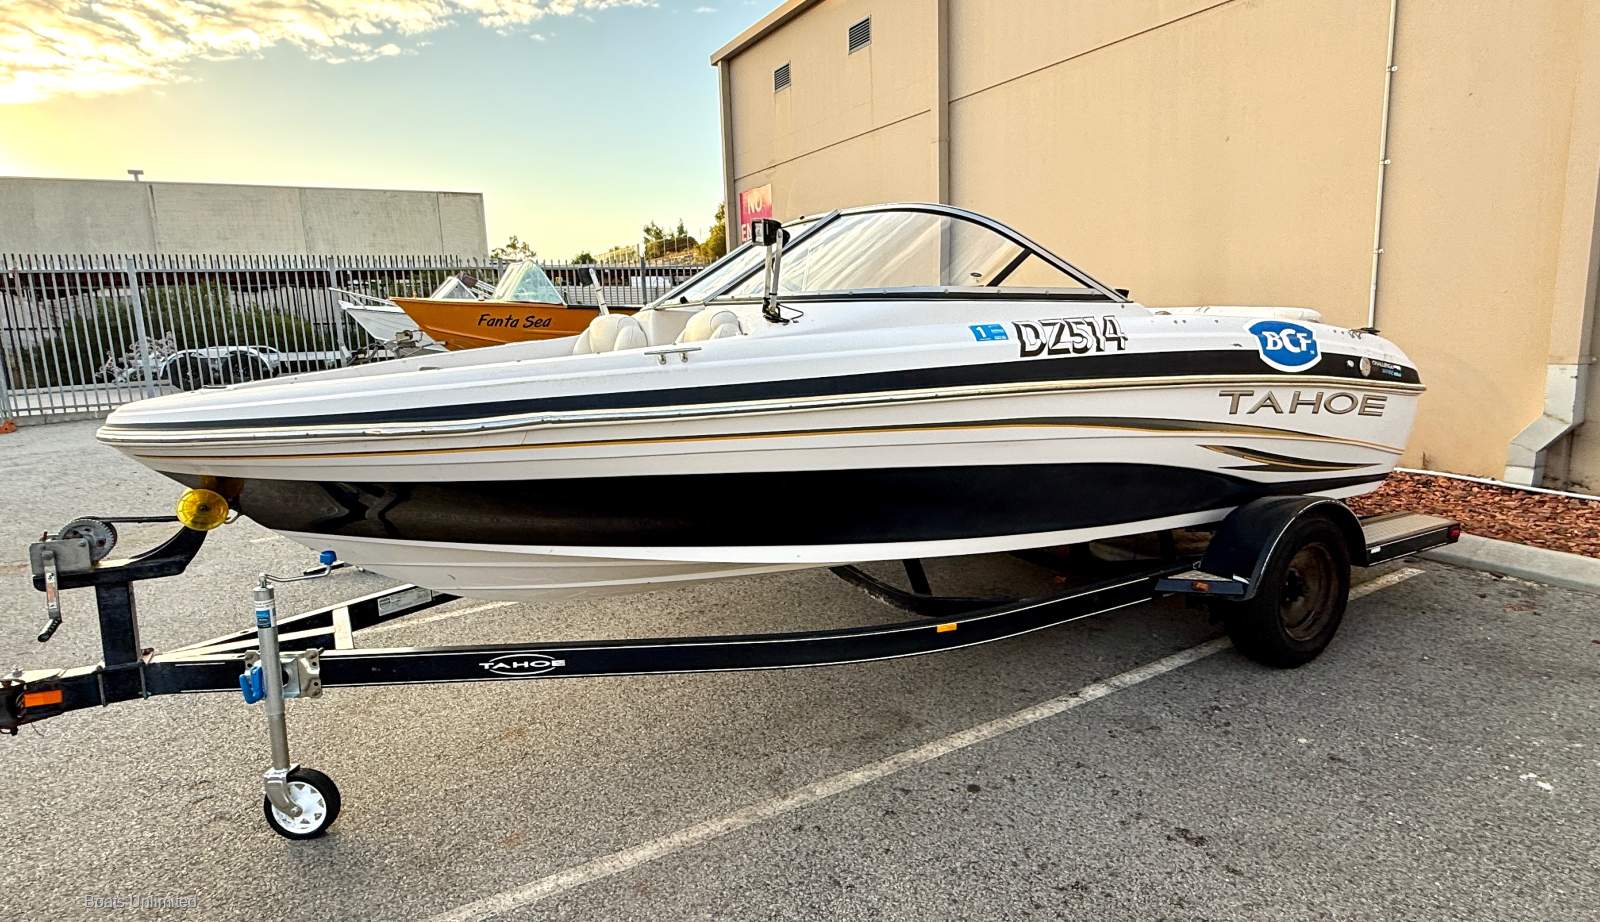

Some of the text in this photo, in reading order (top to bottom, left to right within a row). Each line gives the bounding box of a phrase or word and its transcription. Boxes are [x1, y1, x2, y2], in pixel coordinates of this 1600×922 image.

[747, 191, 763, 214] NO
[478, 313, 552, 329] Fanta Sea
[976, 326, 989, 339] 1
[1011, 315, 1128, 357] DZ514
[1262, 328, 1312, 353] BCF
[1219, 390, 1387, 417] TAHOE
[478, 659, 566, 670] TAHOE
